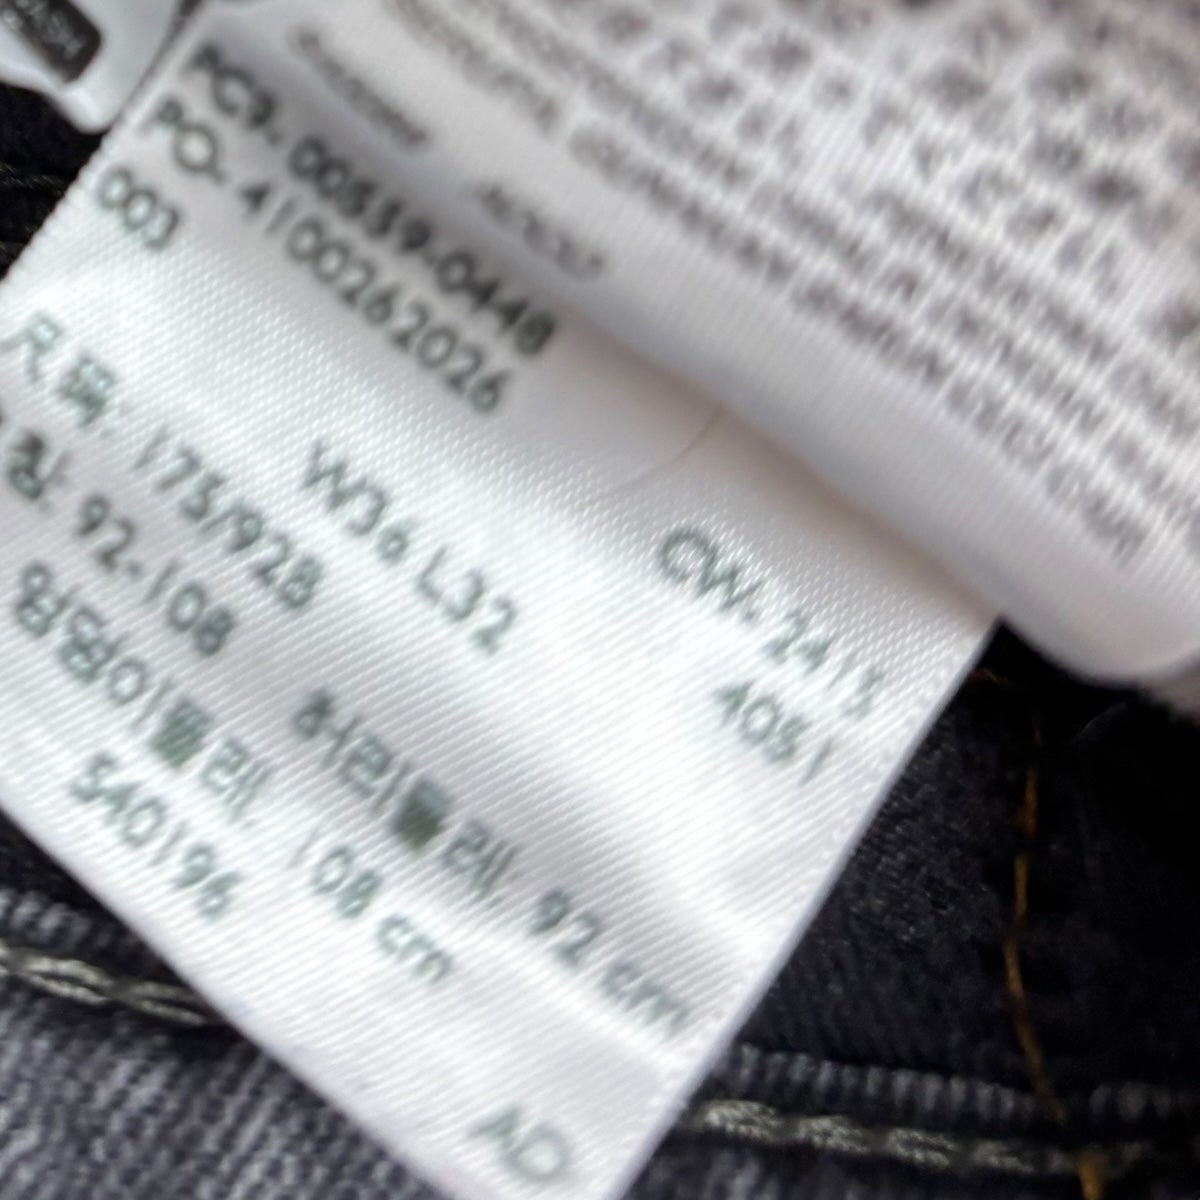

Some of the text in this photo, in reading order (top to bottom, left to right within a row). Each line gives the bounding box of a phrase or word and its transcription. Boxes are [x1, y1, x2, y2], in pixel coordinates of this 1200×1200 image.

[98, 166, 179, 251] 003
[240, 182, 509, 415] 4100262026
[76, 496, 233, 657] 92-108
[304, 438, 518, 655] W36 L32
[290, 827, 383, 920] 108
[376, 913, 455, 984] cm
[527, 888, 602, 966] 92
[600, 960, 689, 1040] cm
